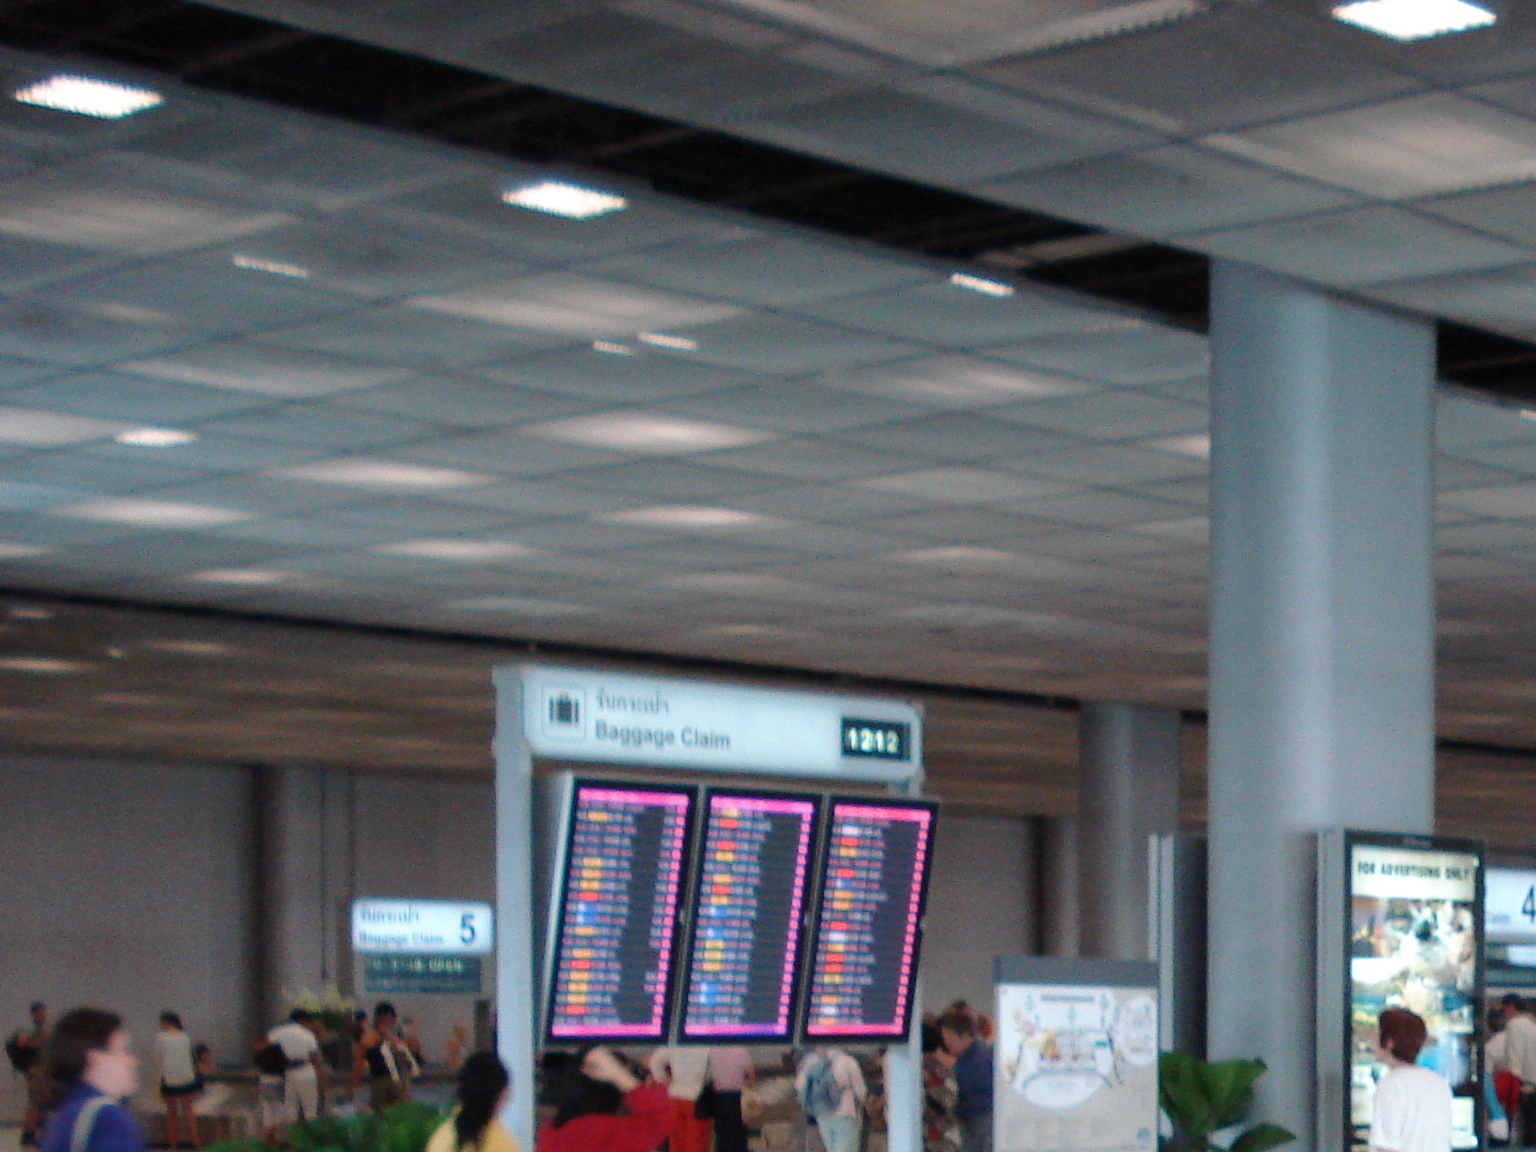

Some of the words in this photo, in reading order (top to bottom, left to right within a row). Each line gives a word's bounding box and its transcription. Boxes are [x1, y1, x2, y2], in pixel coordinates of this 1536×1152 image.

[595, 719, 675, 748] Baggage
[681, 727, 731, 749] Claim
[848, 727, 900, 755] 1212
[459, 913, 476, 944] 5
